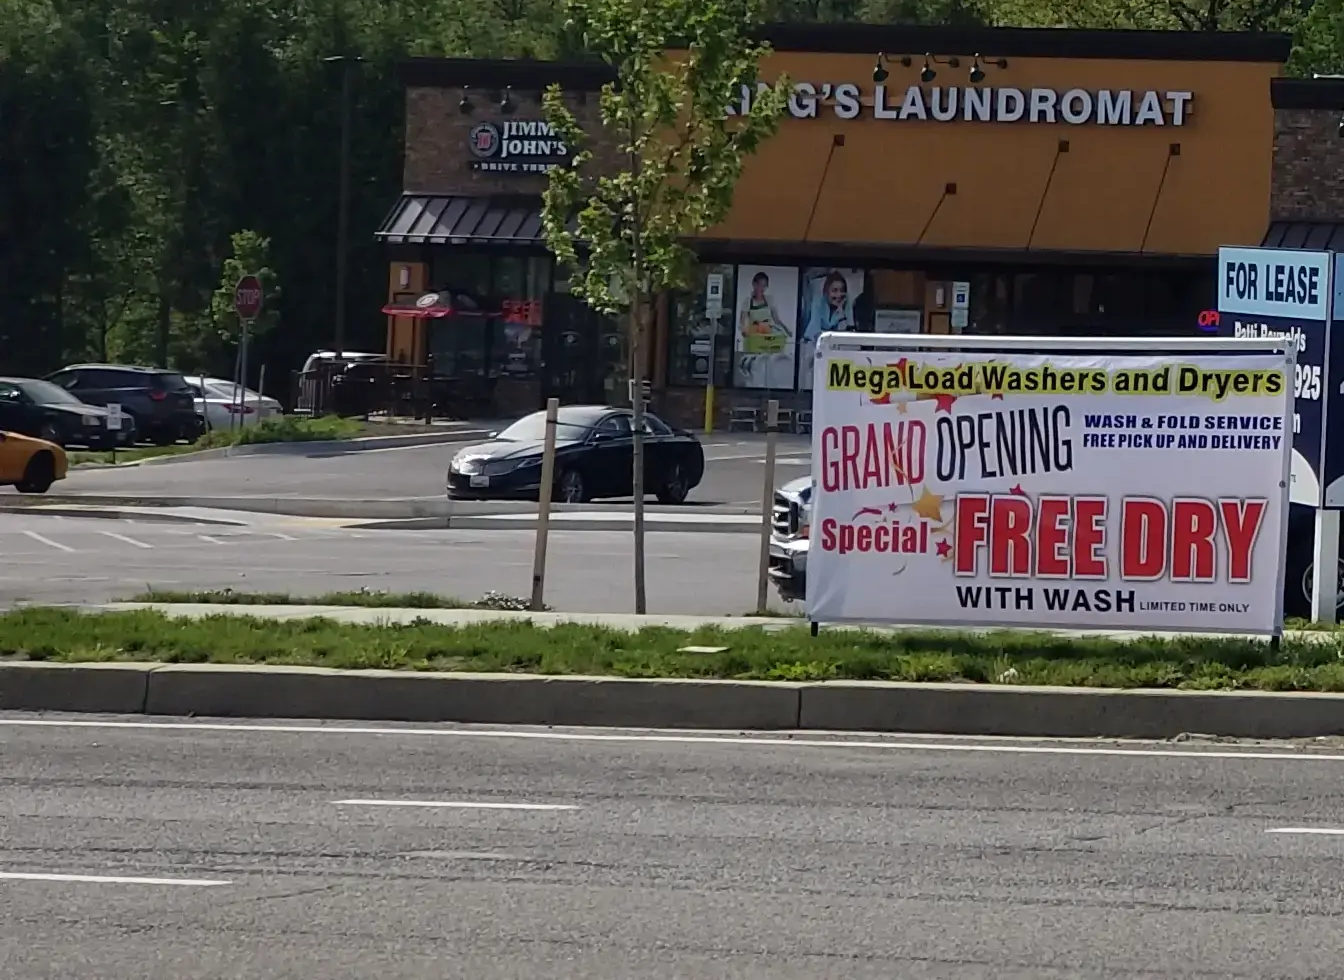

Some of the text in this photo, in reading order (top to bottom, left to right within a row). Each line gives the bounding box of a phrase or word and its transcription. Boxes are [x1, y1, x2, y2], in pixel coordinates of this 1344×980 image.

[873, 85, 1193, 126] LAUNDROMAT
[502, 121, 556, 139] JIMM
[501, 140, 567, 158] JOHN'S
[1226, 262, 1320, 305] FOR LEASE
[829, 362, 900, 395] Mega
[908, 367, 973, 390] Load
[983, 368, 1106, 392] Washers
[1115, 367, 1169, 392] and
[1180, 368, 1282, 399] Dryers
[1084, 414, 1137, 429] WASH
[1141, 416, 1153, 429] &
[1157, 415, 1200, 429] FOLD
[1204, 415, 1282, 430] SERVICE
[821, 405, 1073, 493] GRAND OPENING
[1083, 433, 1281, 450] FREE PICK UP AND DELIVERY
[821, 517, 928, 555] Special
[954, 492, 1269, 584] FREE DRY
[956, 585, 1136, 614] WITH WASH
[1139, 601, 1250, 613] LIMITED TIME ONLY
